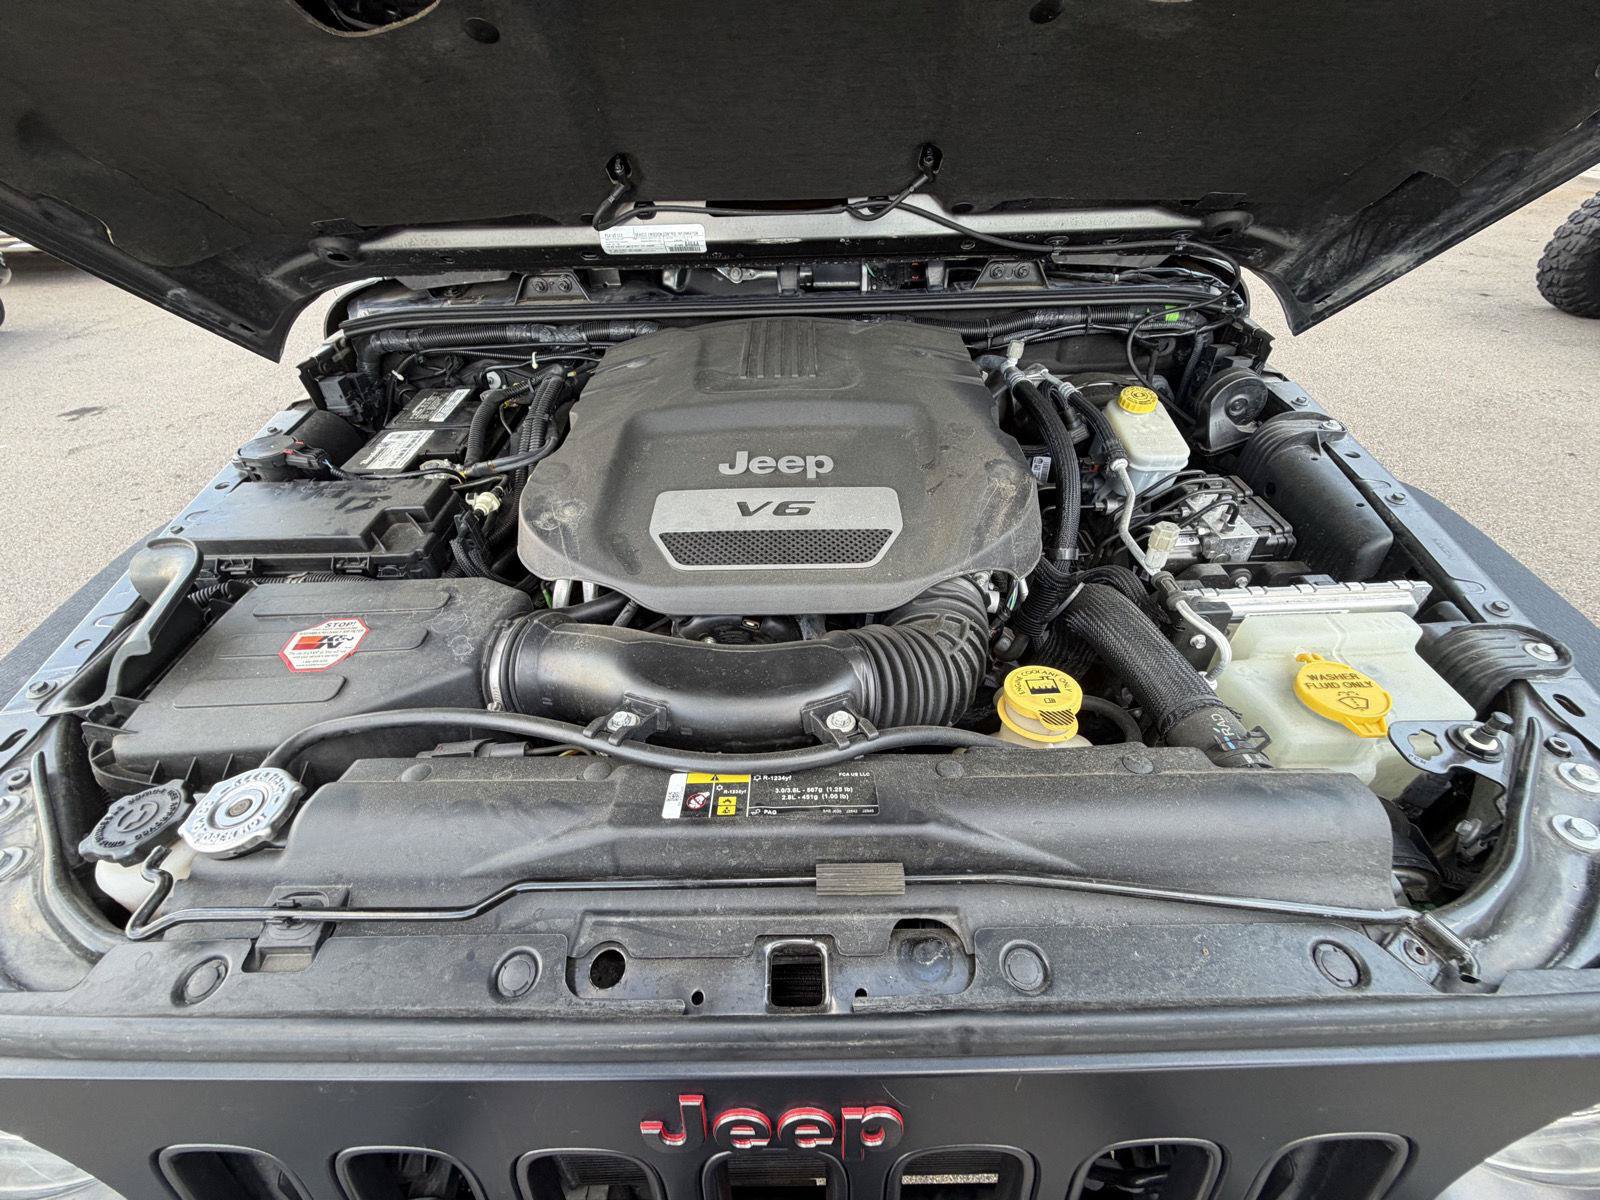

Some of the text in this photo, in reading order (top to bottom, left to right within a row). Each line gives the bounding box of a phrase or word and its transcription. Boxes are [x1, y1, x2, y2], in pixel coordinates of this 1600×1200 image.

[718, 450, 834, 478] Jeep
[736, 500, 816, 516] V6
[1014, 669, 1073, 695] ENGINE COOLANT ONLY
[1305, 680, 1374, 690] FLUID ONLY
[1306, 672, 1360, 681] WASHER
[640, 1094, 904, 1160] Jeep
